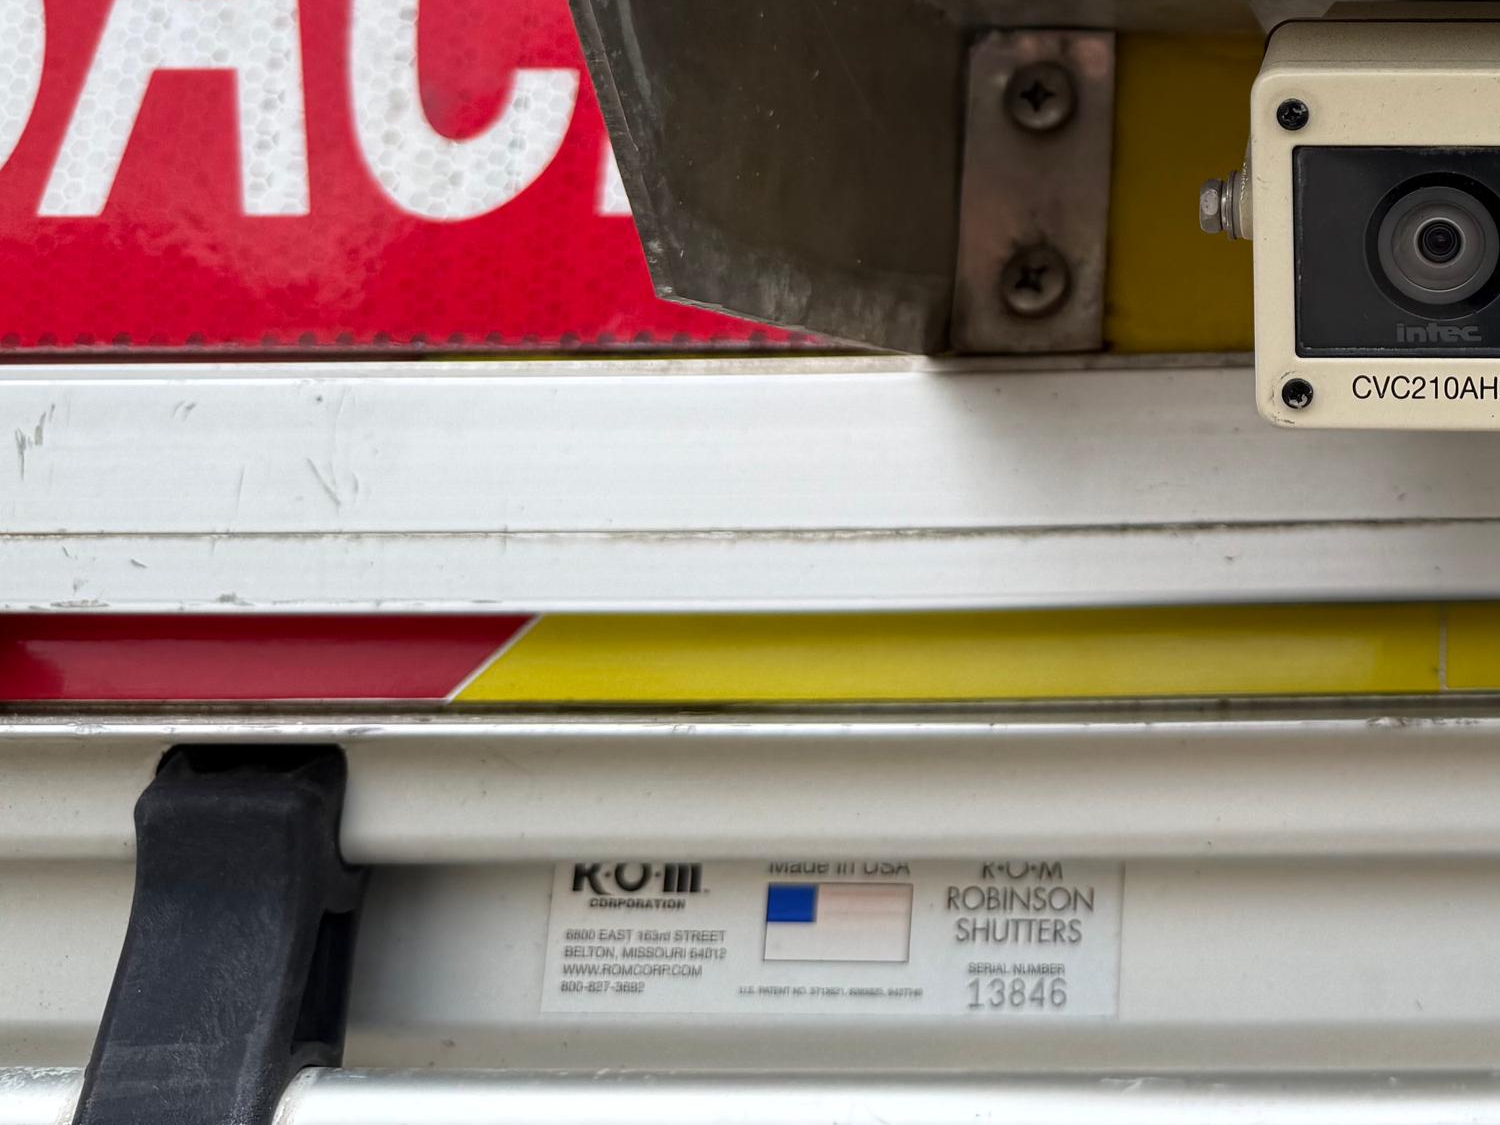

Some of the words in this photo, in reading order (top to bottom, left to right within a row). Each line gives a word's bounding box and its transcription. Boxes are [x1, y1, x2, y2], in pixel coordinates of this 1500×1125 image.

[1396, 324, 1482, 343] intec
[588, 897, 686, 910] CORPORATION
[946, 885, 1095, 913] ROBINSON
[599, 928, 633, 942] EAST
[673, 929, 726, 943] STREET
[954, 917, 1083, 944] SHUTTERS
[622, 947, 687, 959] MISSOURI
[562, 963, 703, 977] WWW.ROMCORP.COM
[967, 962, 1009, 974] SERIAL
[1012, 963, 1066, 976] NUMBER
[966, 976, 1069, 1008] 13846
